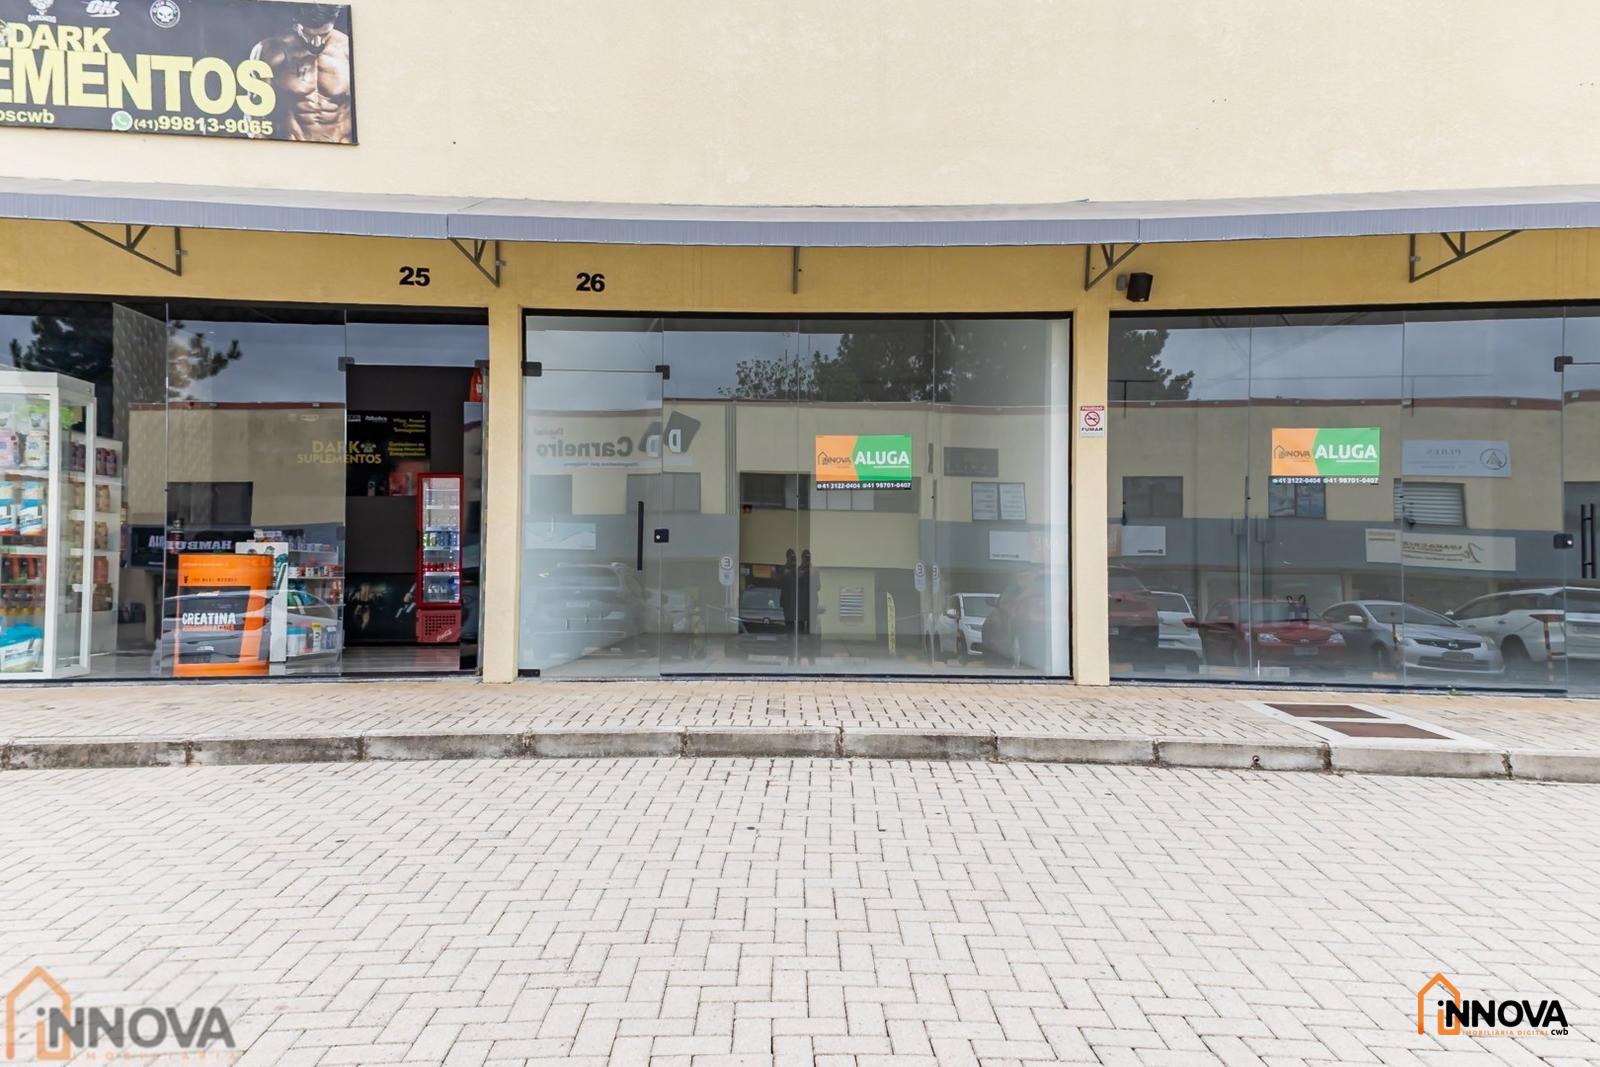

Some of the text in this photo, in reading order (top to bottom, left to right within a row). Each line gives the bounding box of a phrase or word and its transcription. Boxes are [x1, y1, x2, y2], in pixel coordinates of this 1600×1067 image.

[7, 22, 111, 53] DARK
[399, 266, 430, 286] 25
[576, 273, 605, 292] 26
[311, 440, 360, 454] DARK
[1315, 444, 1377, 459] ALUGA
[296, 454, 382, 464] SUPLEMENTOS
[854, 450, 910, 465] ALUGA
[182, 612, 236, 625] CREATINA
